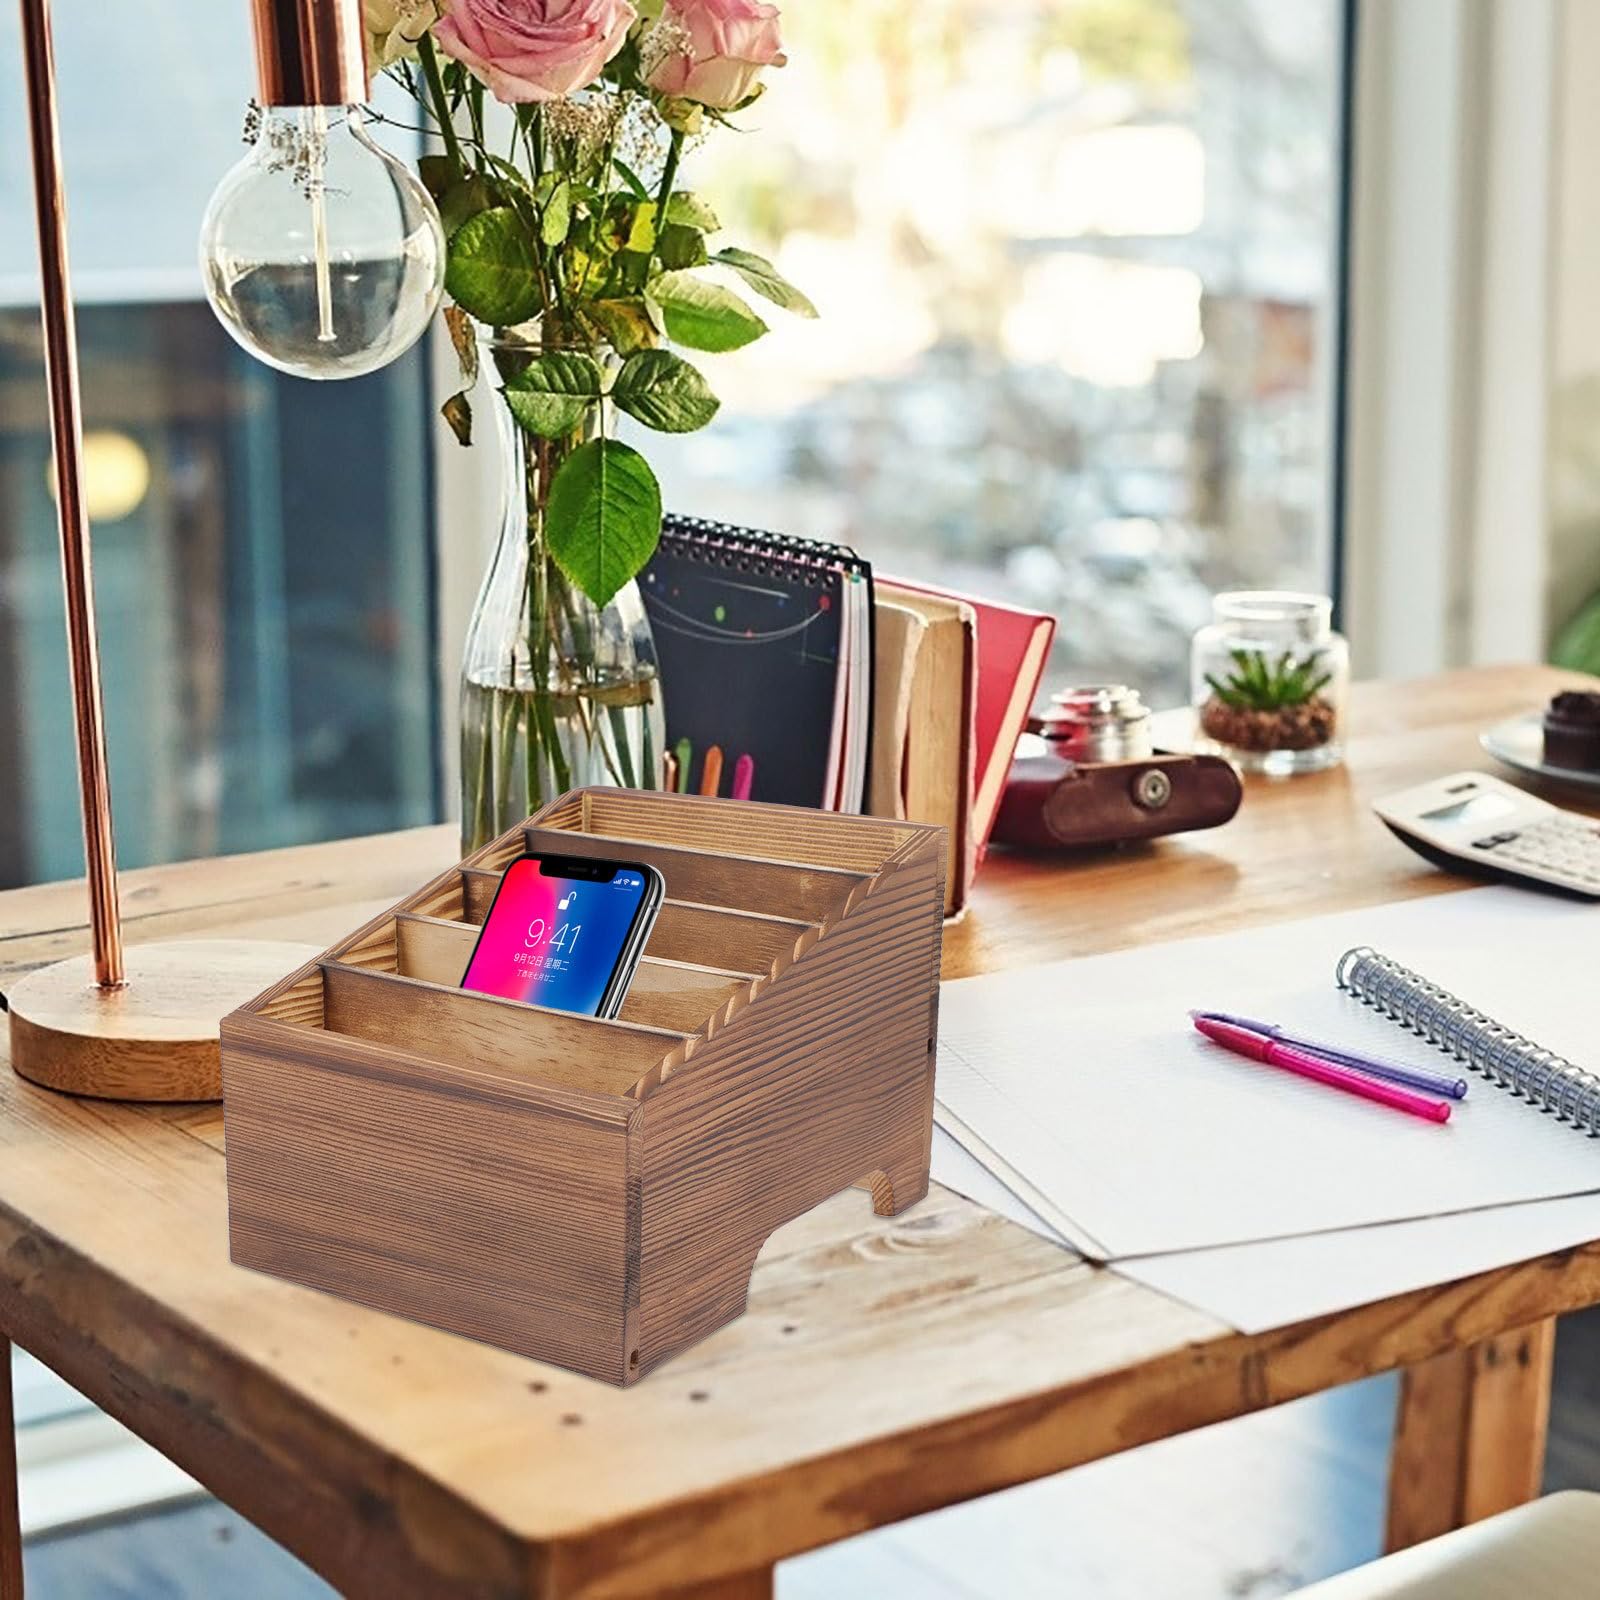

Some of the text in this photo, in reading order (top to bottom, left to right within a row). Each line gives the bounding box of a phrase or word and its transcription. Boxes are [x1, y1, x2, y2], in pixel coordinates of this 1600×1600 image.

[524, 918, 582, 954] 9:41
[513, 952, 570, 971] 9月12日 星期二
